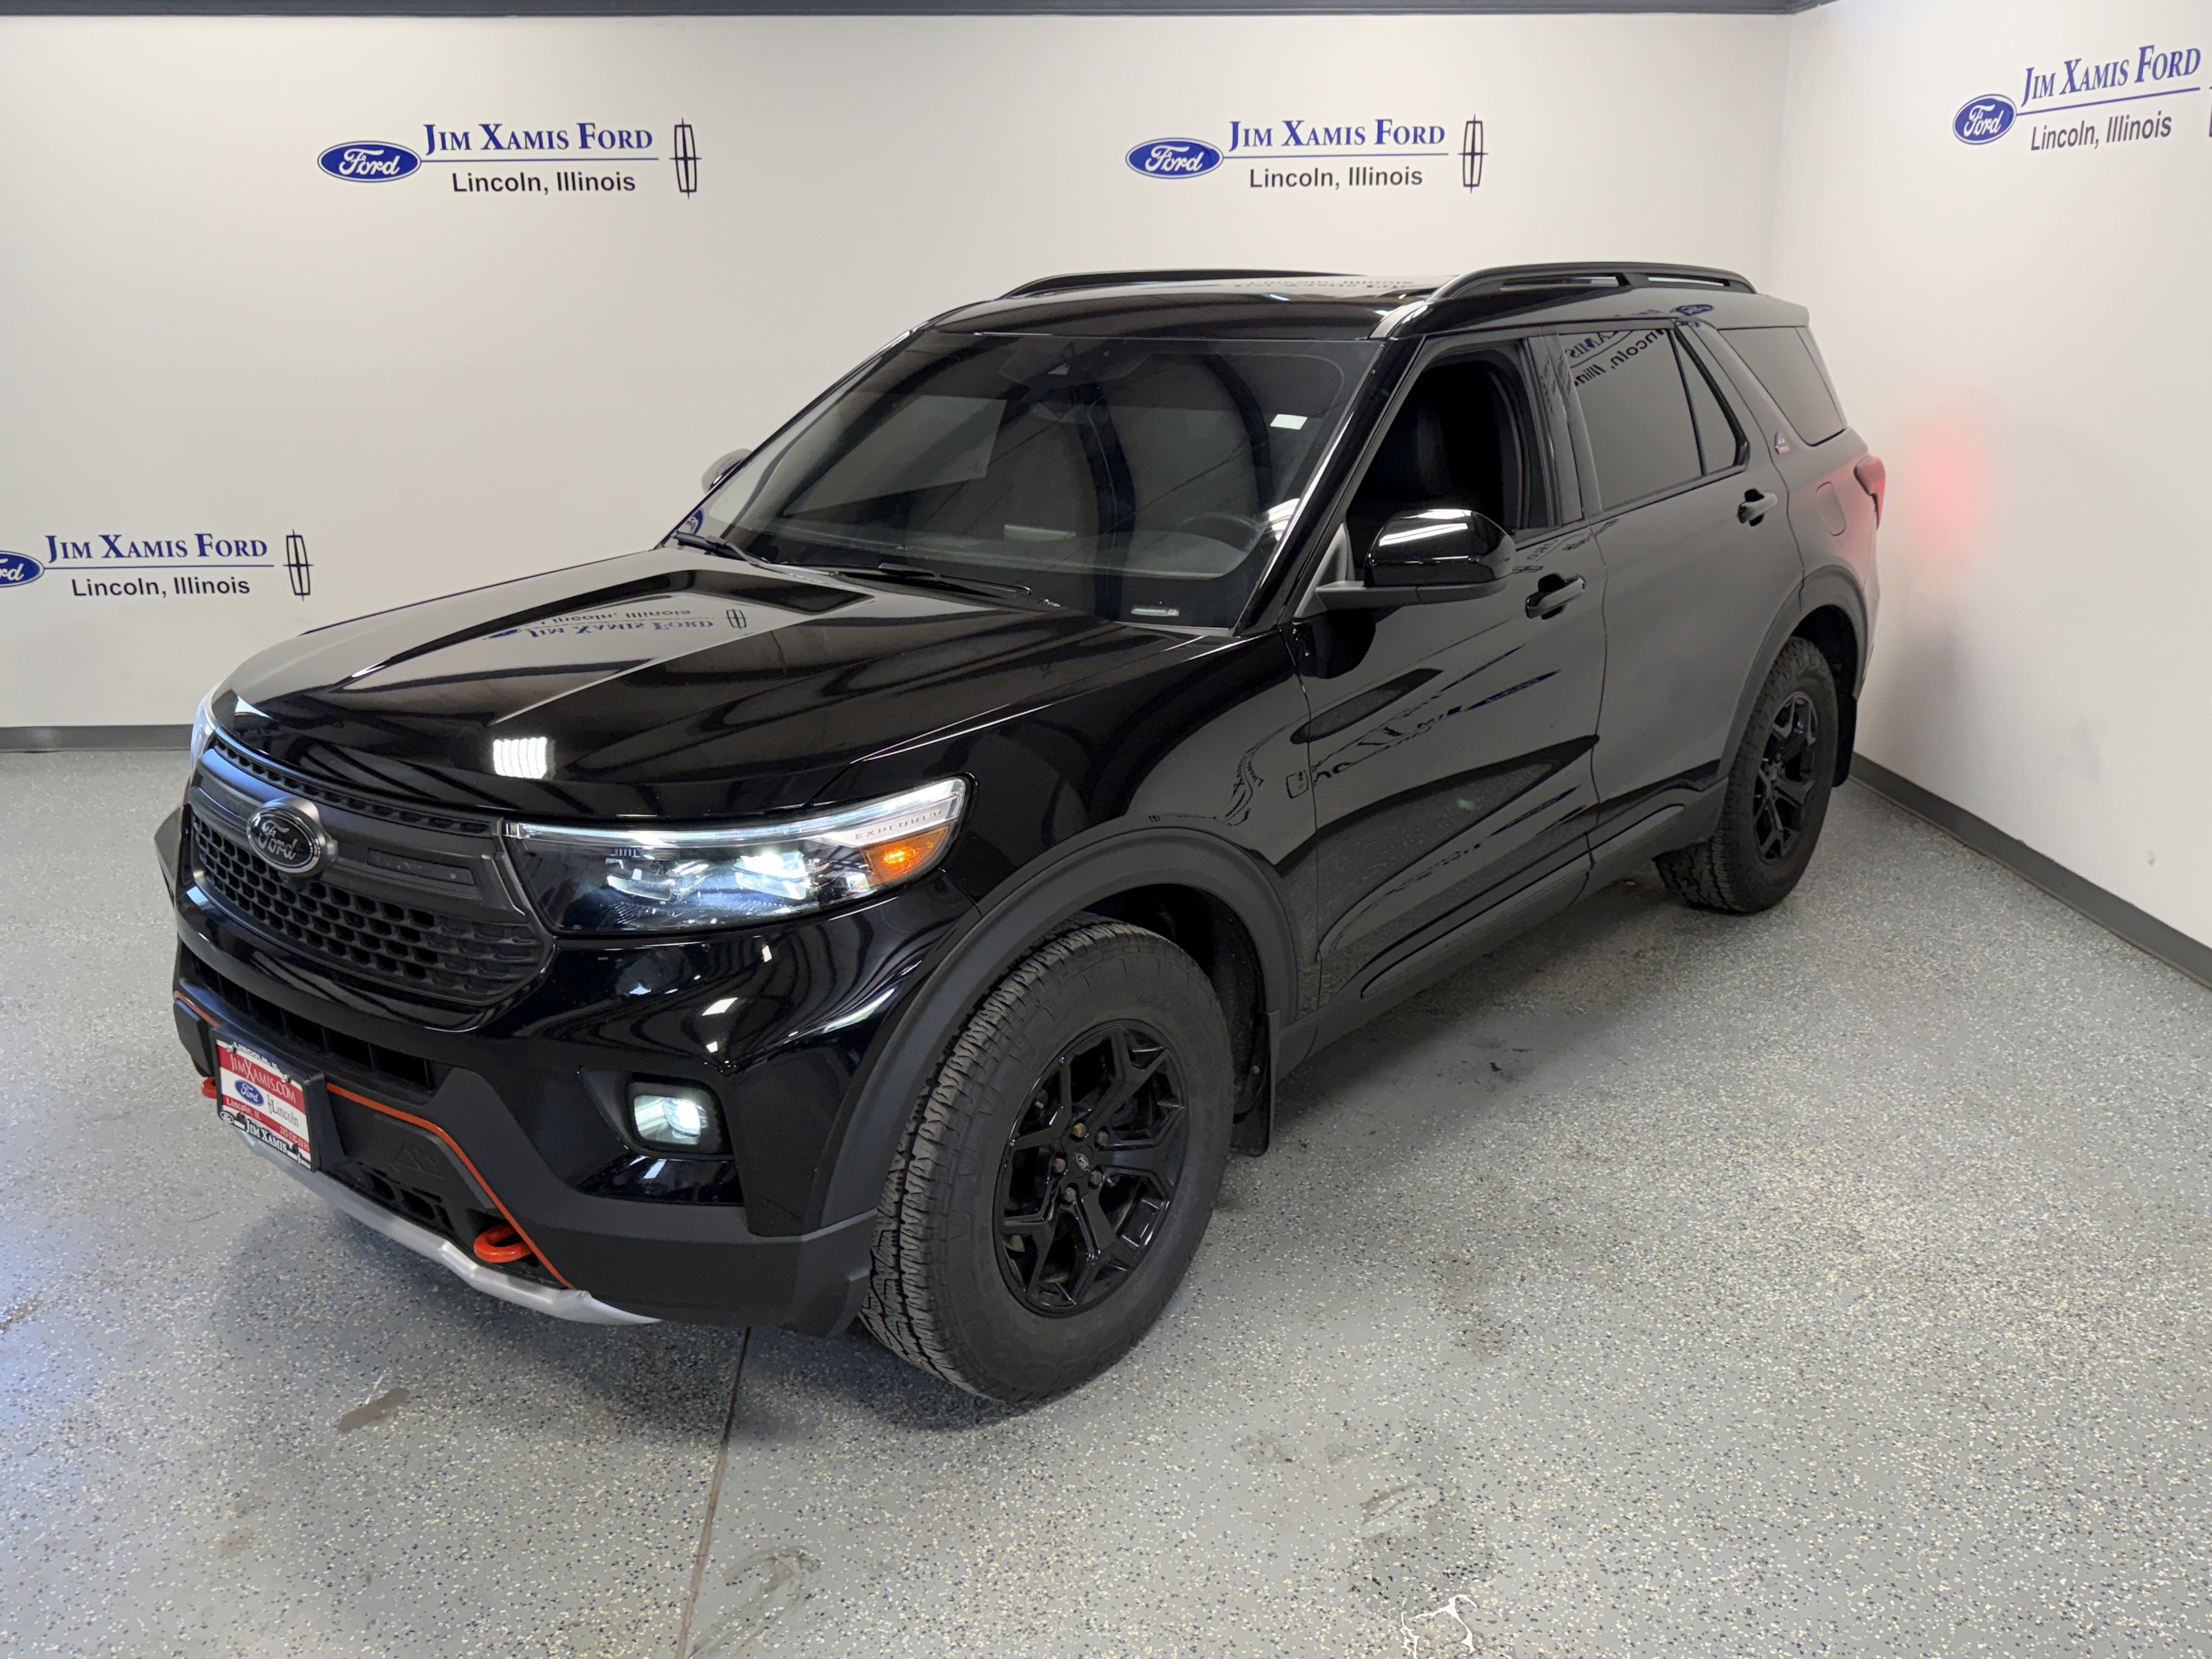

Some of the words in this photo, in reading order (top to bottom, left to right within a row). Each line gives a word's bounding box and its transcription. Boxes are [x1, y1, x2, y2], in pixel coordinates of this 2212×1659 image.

[2031, 121, 2099, 150] Lincoln,
[2106, 111, 2172, 143] Illinois
[452, 172, 549, 195] Lincoln,
[556, 171, 636, 191] Illinois
[1250, 168, 1340, 190] Lincoln,
[1348, 166, 1423, 186] Illinois
[71, 577, 167, 599] Lincoln,
[173, 577, 250, 595] Illinois
[855, 809, 942, 839] EXPLORER
[272, 1100, 299, 1128] Lincoln
